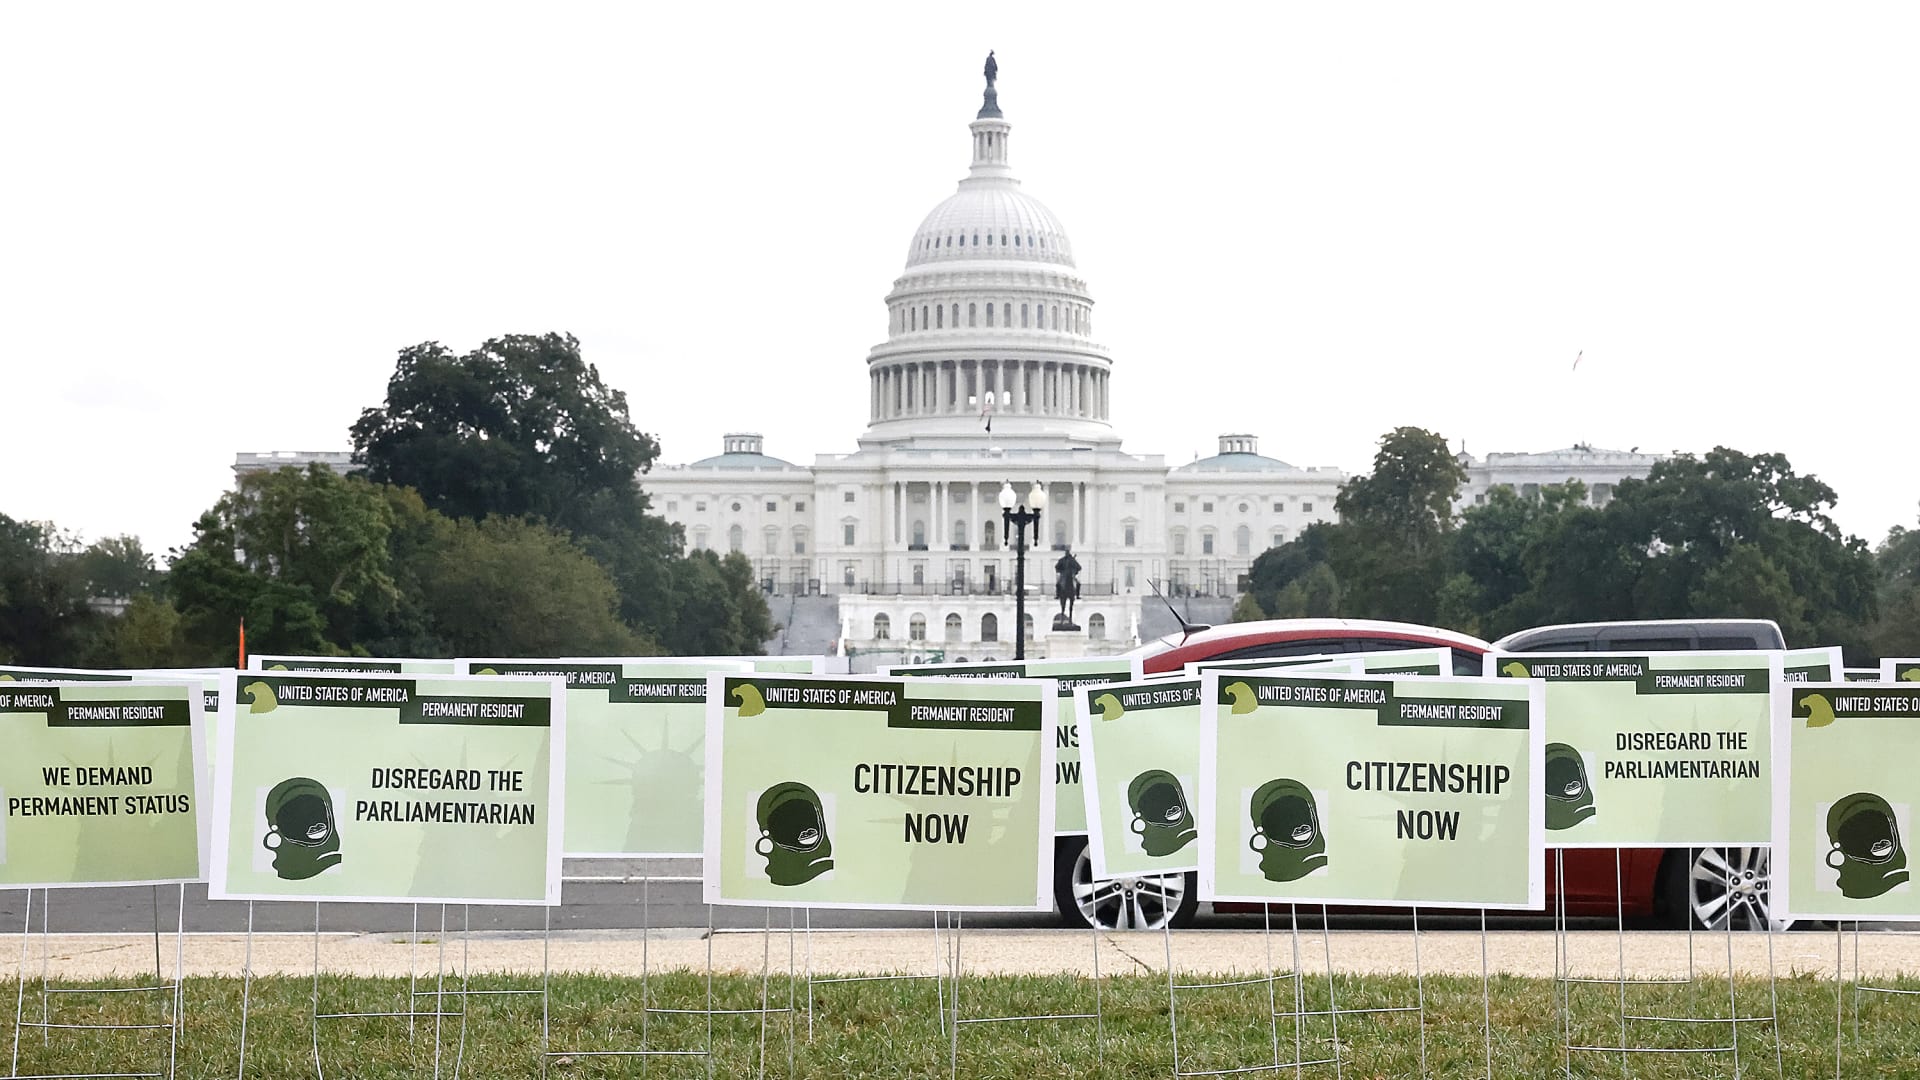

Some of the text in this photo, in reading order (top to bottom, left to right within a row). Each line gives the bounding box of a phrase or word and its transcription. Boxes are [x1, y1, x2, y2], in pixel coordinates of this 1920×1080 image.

[579, 672, 616, 684] AMERICA
[1532, 664, 1642, 676] UNITED STATES OF AMERICA
[1656, 675, 1745, 687] PERMANENT RESIDENT
[279, 686, 408, 702] UNITED STATES OF AMERICA
[629, 684, 677, 696] PERMANENT
[767, 688, 896, 705] UNITED STATES OF AMERICA
[1123, 692, 1151, 706] UNITED
[1153, 690, 1181, 703] STATES
[1183, 689, 1192, 700] OF
[1259, 686, 1386, 703] UNITED STATES OF AMERICA
[0, 695, 54, 707] OF AMERICA
[1836, 697, 1920, 711] UNITED STATES O
[69, 707, 164, 719] PERMANENT RESIDENT
[423, 703, 524, 717] PERMANENT RESIDENT
[912, 706, 1014, 721] PERMANENT RESIDENT
[1401, 704, 1502, 720] PERMANENT RESIDENT
[1617, 732, 1747, 750] DISREGARD THE
[43, 767, 152, 785] WE DEMAND
[1347, 761, 1509, 794] CITIZENSHIP
[1606, 761, 1759, 778] PARLIAMENTARIAN
[372, 768, 522, 791] DISREGARD THE
[855, 764, 1020, 796] CITIZENSHIP
[9, 795, 189, 816] PERMANENT STATUS
[356, 801, 534, 824] PARLIAMENTARIAN
[905, 813, 968, 843] NOW
[1398, 810, 1459, 840] NOW
